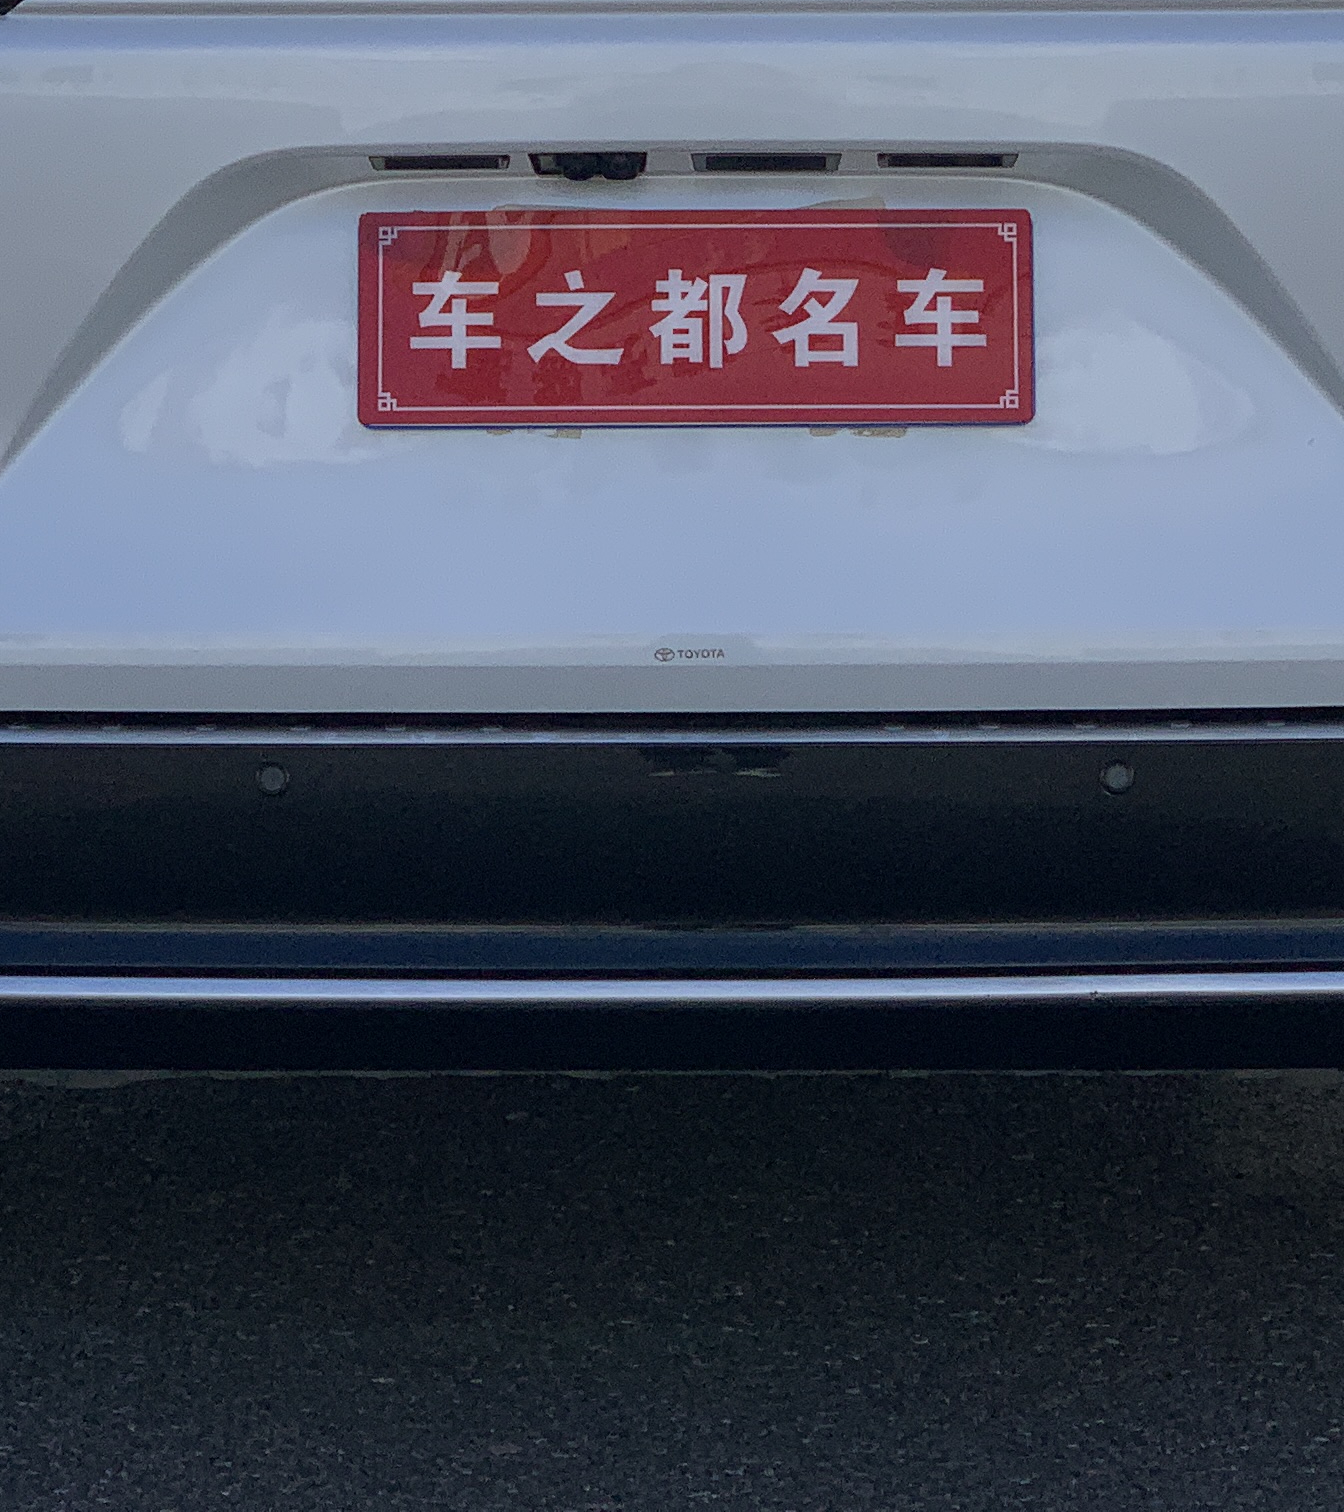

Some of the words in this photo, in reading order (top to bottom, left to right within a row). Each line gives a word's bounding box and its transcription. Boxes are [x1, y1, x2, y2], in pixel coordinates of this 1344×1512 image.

[409, 268, 988, 369] 车之都名车
[677, 648, 725, 659] TOYOTA
